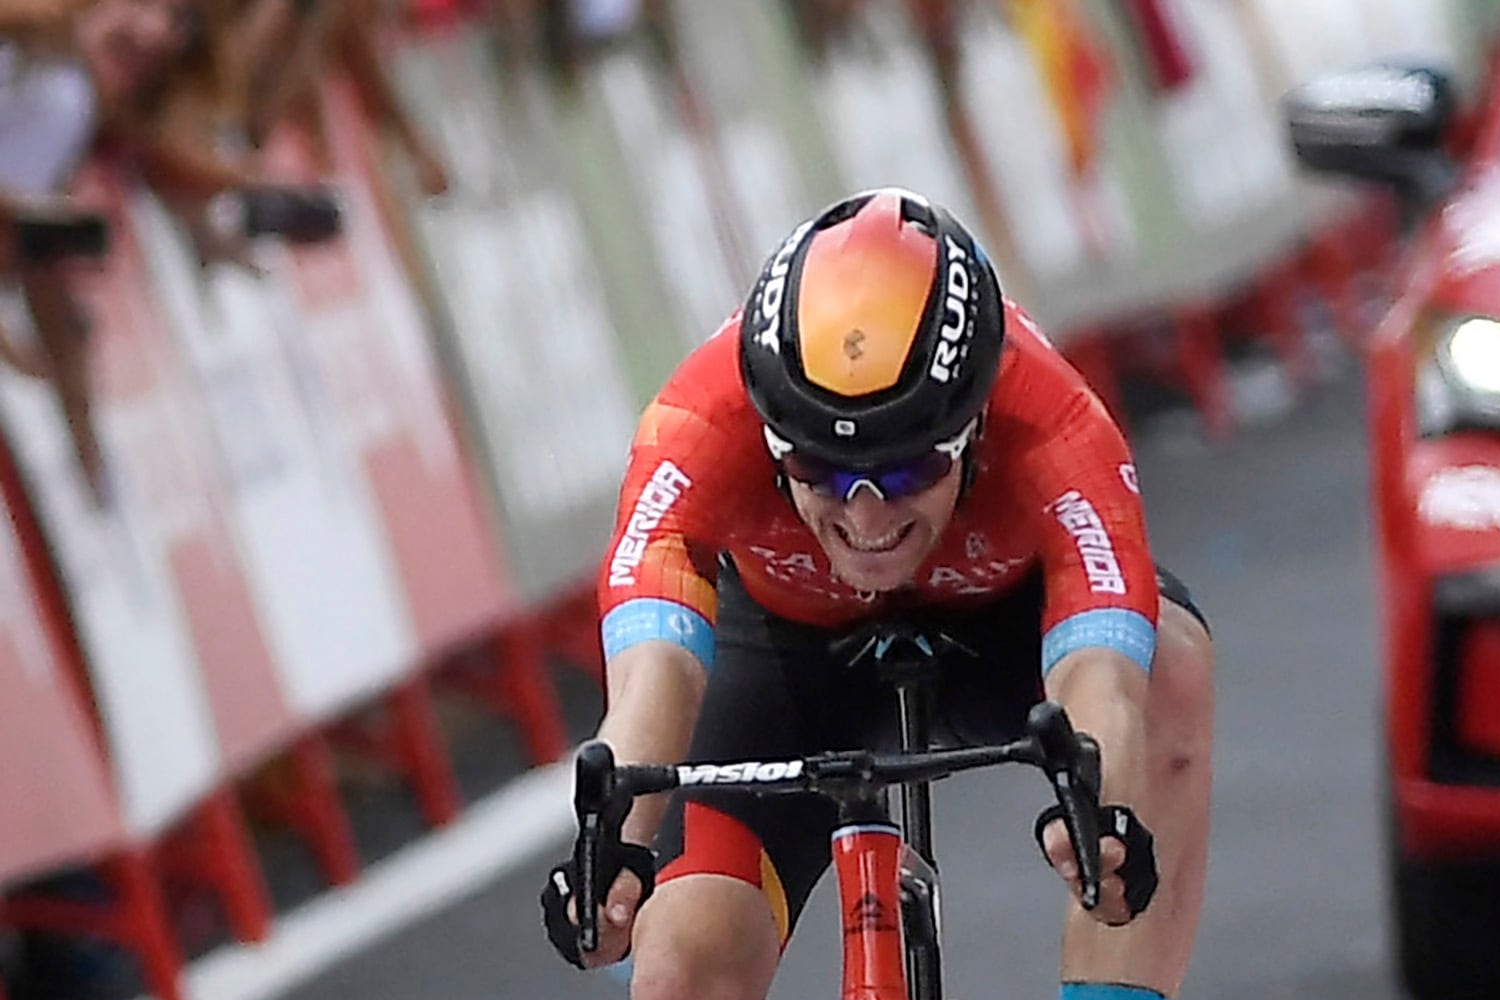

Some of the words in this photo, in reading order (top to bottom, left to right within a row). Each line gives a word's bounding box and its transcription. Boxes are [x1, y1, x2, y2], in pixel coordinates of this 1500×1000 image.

[930, 234, 969, 383] RUDY
[608, 460, 692, 587] MERIDA
[1043, 489, 1127, 595] MERIDA
